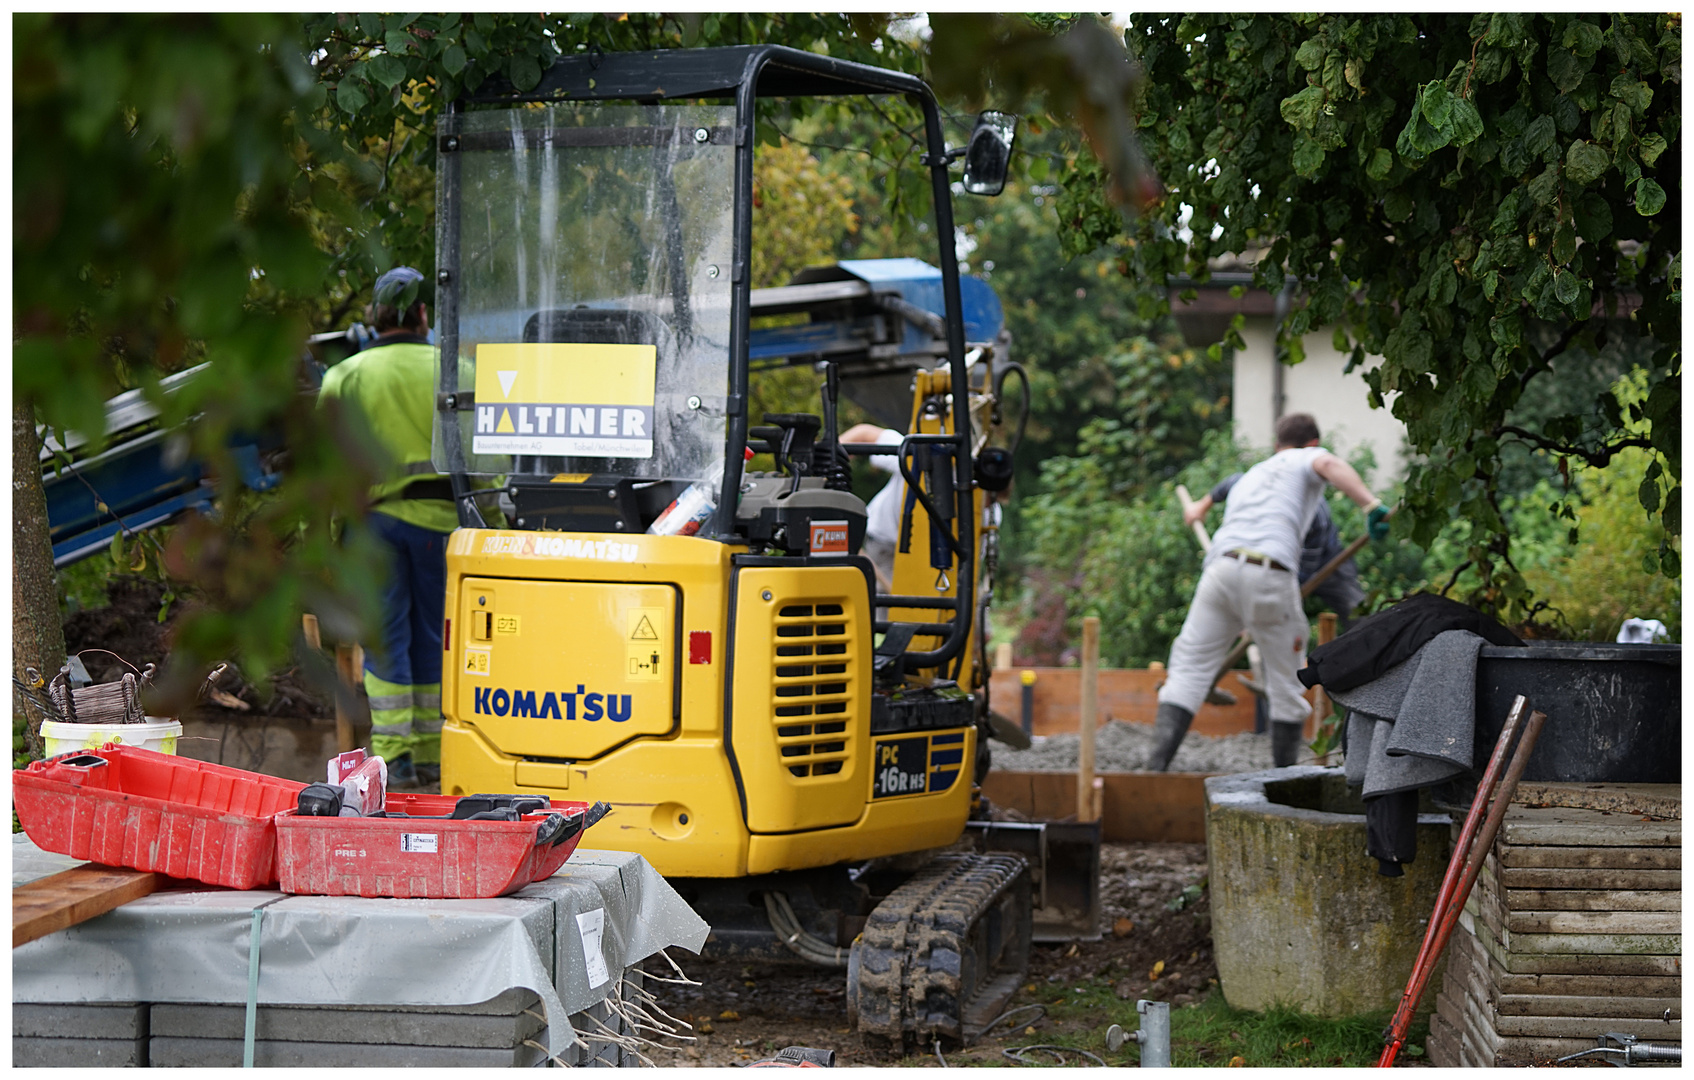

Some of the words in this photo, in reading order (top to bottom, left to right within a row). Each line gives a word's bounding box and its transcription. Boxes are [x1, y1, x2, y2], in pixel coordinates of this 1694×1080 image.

[477, 406, 646, 436] HALTINER
[531, 441, 543, 450] AG
[825, 530, 847, 541] KUHN
[474, 684, 632, 722] KOMATSU
[882, 745, 899, 765] PC
[910, 773, 925, 789] HS
[335, 849, 357, 857] PRE
[359, 849, 367, 857] 3
